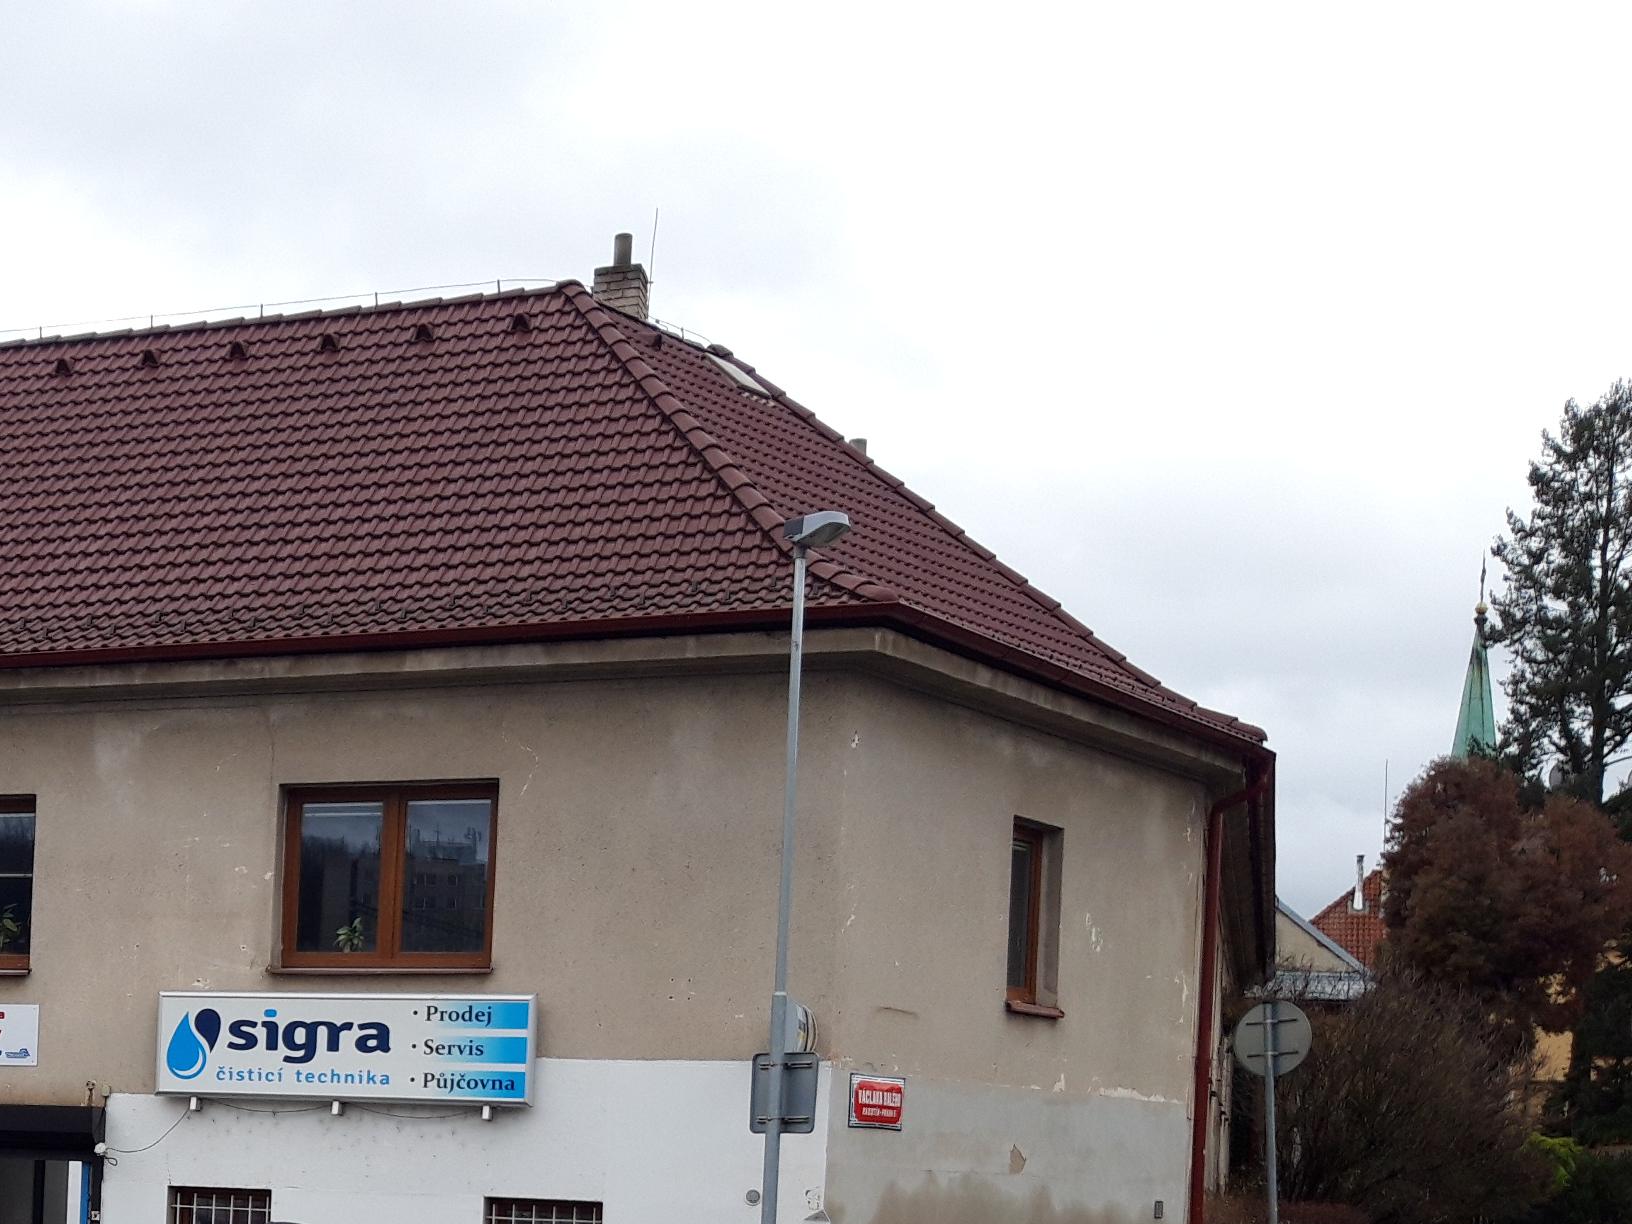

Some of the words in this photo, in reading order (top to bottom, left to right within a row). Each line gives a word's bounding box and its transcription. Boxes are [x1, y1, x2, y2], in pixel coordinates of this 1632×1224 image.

[425, 1005, 492, 1028] Prodej
[226, 1008, 392, 1065] sigra
[423, 1039, 484, 1057] Servis
[215, 1066, 283, 1083] čisticí
[295, 1069, 391, 1085] technika
[422, 1071, 515, 1094] Půjčovna
